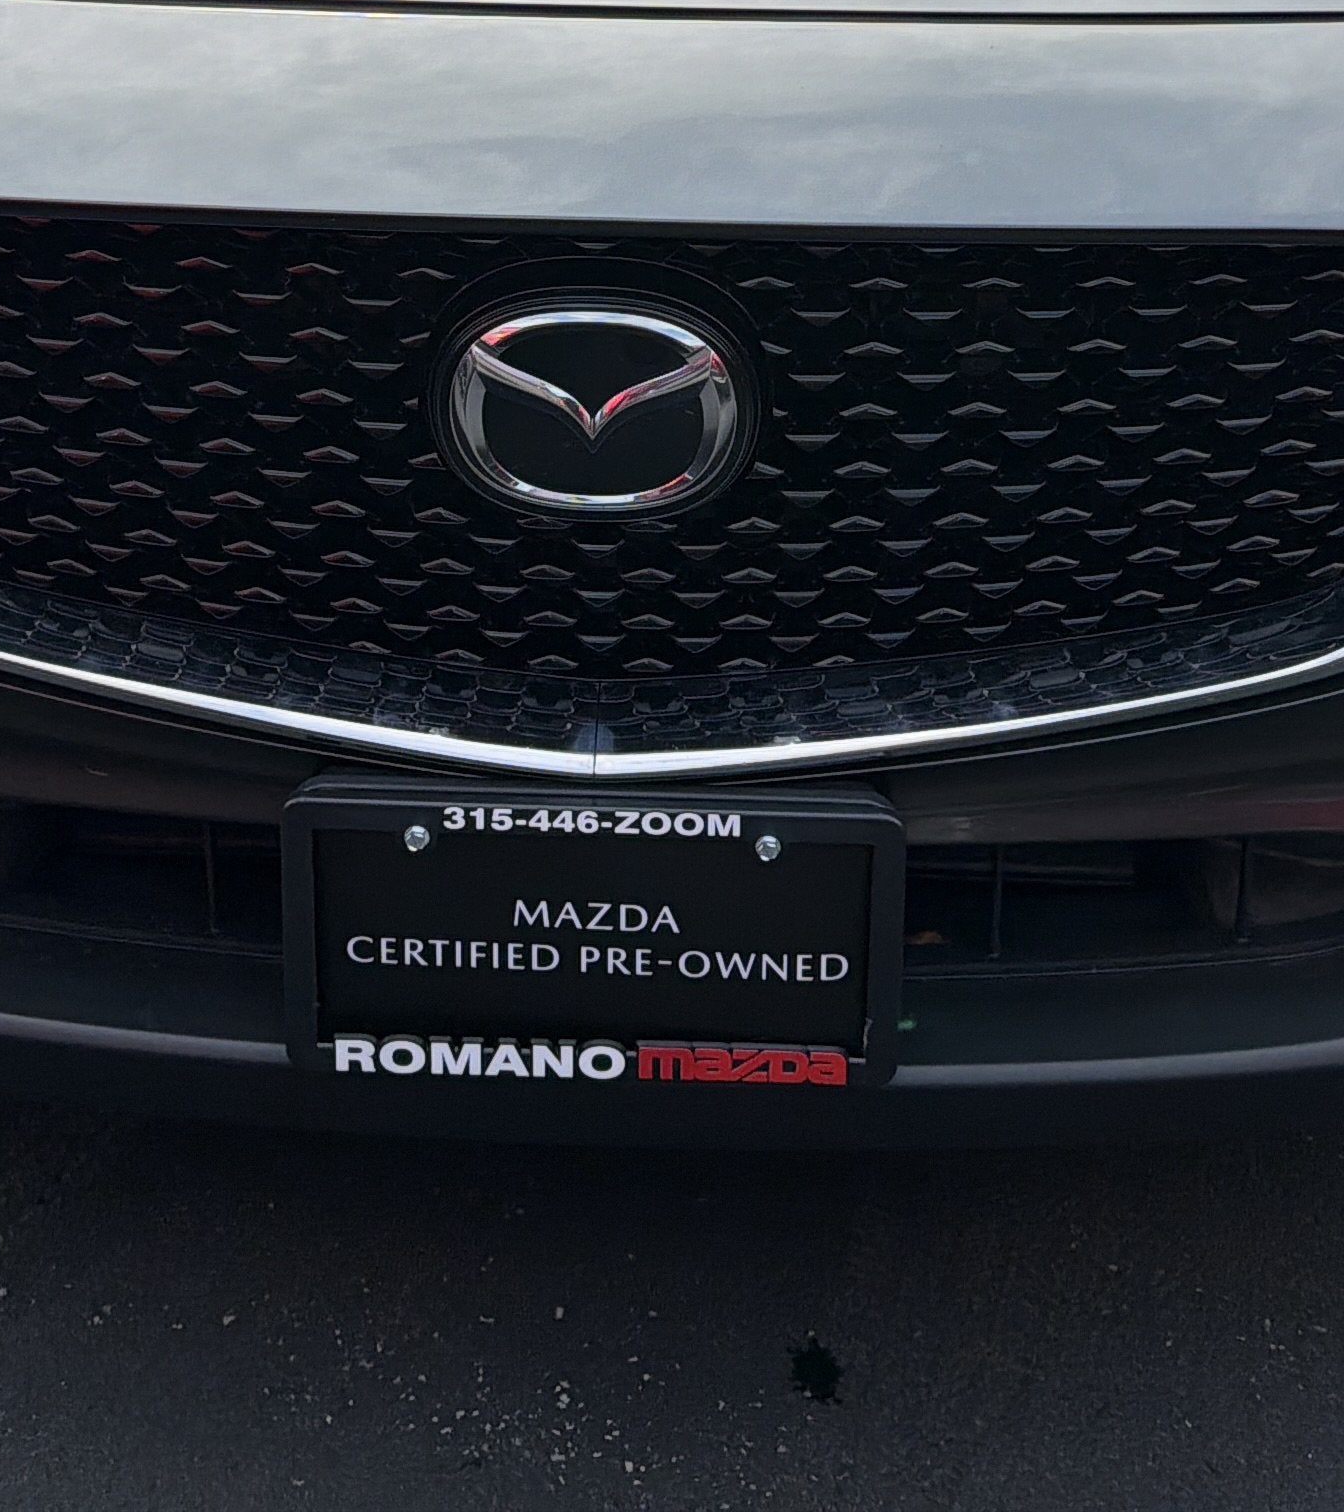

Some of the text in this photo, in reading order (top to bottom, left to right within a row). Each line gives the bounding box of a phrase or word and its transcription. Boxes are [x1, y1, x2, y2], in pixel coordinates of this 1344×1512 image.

[442, 806, 743, 839] 315-446-ZOOM
[512, 899, 681, 934] MAZDA
[346, 935, 850, 982] CERTIFIED PRE-OWNED
[334, 1038, 848, 1086] ROMANO mazda
